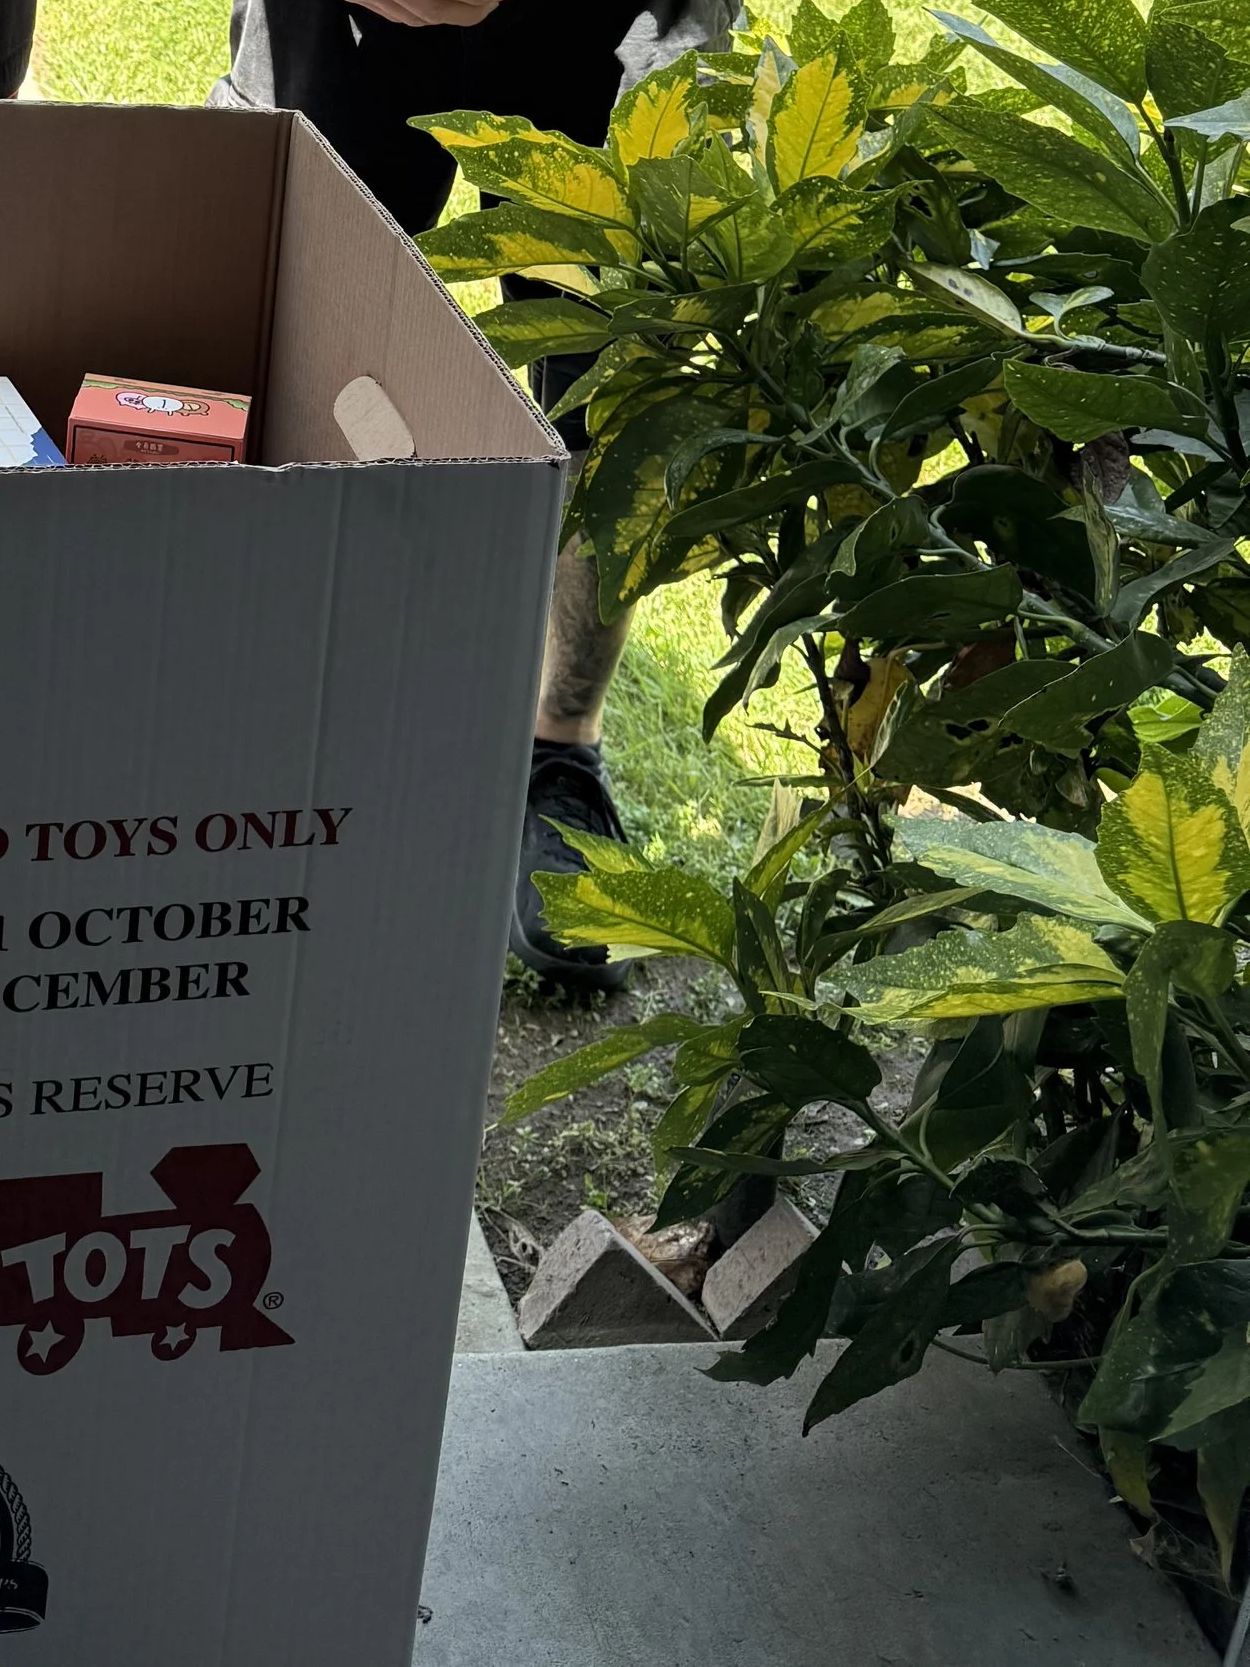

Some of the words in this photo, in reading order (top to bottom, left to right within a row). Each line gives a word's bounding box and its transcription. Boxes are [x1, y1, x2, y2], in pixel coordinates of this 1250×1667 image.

[25, 815, 179, 862] TOYS
[194, 807, 353, 852] ONLY
[28, 896, 311, 950] OCTOBER
[29, 1062, 274, 1116] RESERVE
[0, 1225, 236, 1310] TOTS
